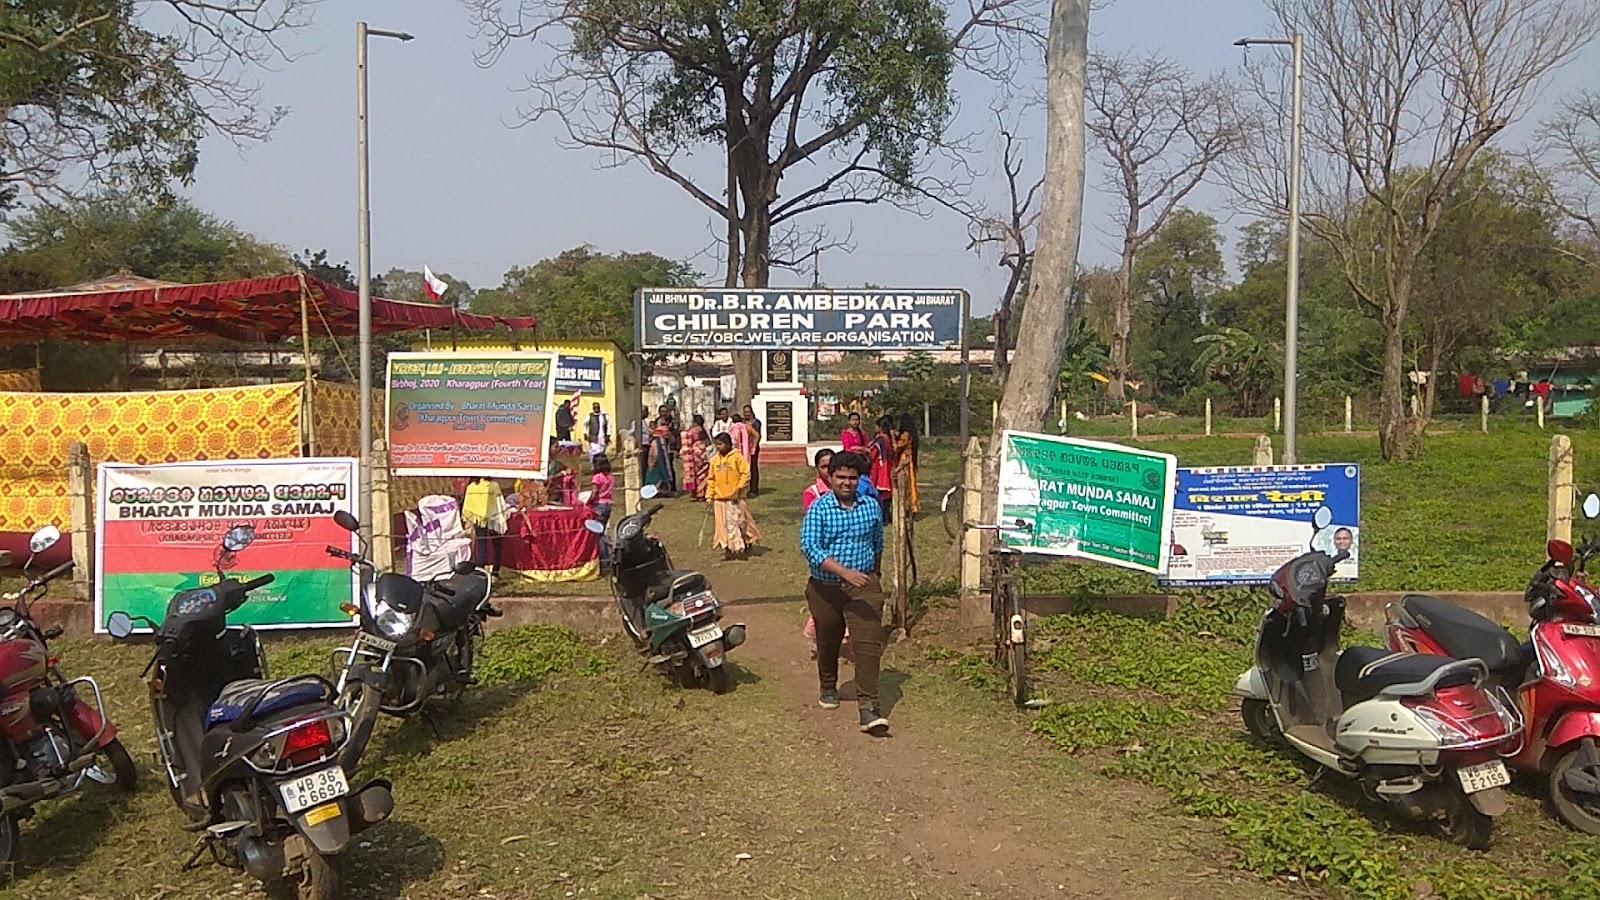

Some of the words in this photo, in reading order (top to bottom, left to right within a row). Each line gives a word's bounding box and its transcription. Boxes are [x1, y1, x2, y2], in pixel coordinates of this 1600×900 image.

[650, 294, 663, 304] JAI
[664, 294, 687, 304] BHIM
[774, 294, 914, 311] AMBEDKAR
[915, 295, 926, 306] JAI
[926, 295, 956, 306] BHARAT
[654, 313, 815, 330] CHILDREN
[845, 312, 934, 329] PARK
[662, 331, 744, 346] SC/ST/OBC
[748, 331, 822, 344] WELFARE
[825, 330, 936, 343] ORGANISATION
[577, 368, 601, 381] PARK
[419, 379, 441, 388] 2020
[446, 379, 489, 391] Kharagpur
[491, 379, 521, 390] (Fourth
[523, 379, 546, 390] Year)
[461, 401, 486, 411] Bharat
[487, 401, 516, 411] Munda
[517, 402, 543, 413] Samaj
[459, 413, 480, 422] Town
[1066, 483, 1114, 502] MUNDA
[1115, 491, 1158, 511] SAMAJ
[119, 504, 194, 518] BHARAT
[199, 503, 267, 517] MUNDA
[271, 502, 336, 516] SAMAJ
[1071, 499, 1099, 513] Town
[1099, 505, 1152, 527] Committee)
[1467, 767, 1481, 778] WB
[296, 778, 315, 793] WB
[318, 770, 336, 786] 36
